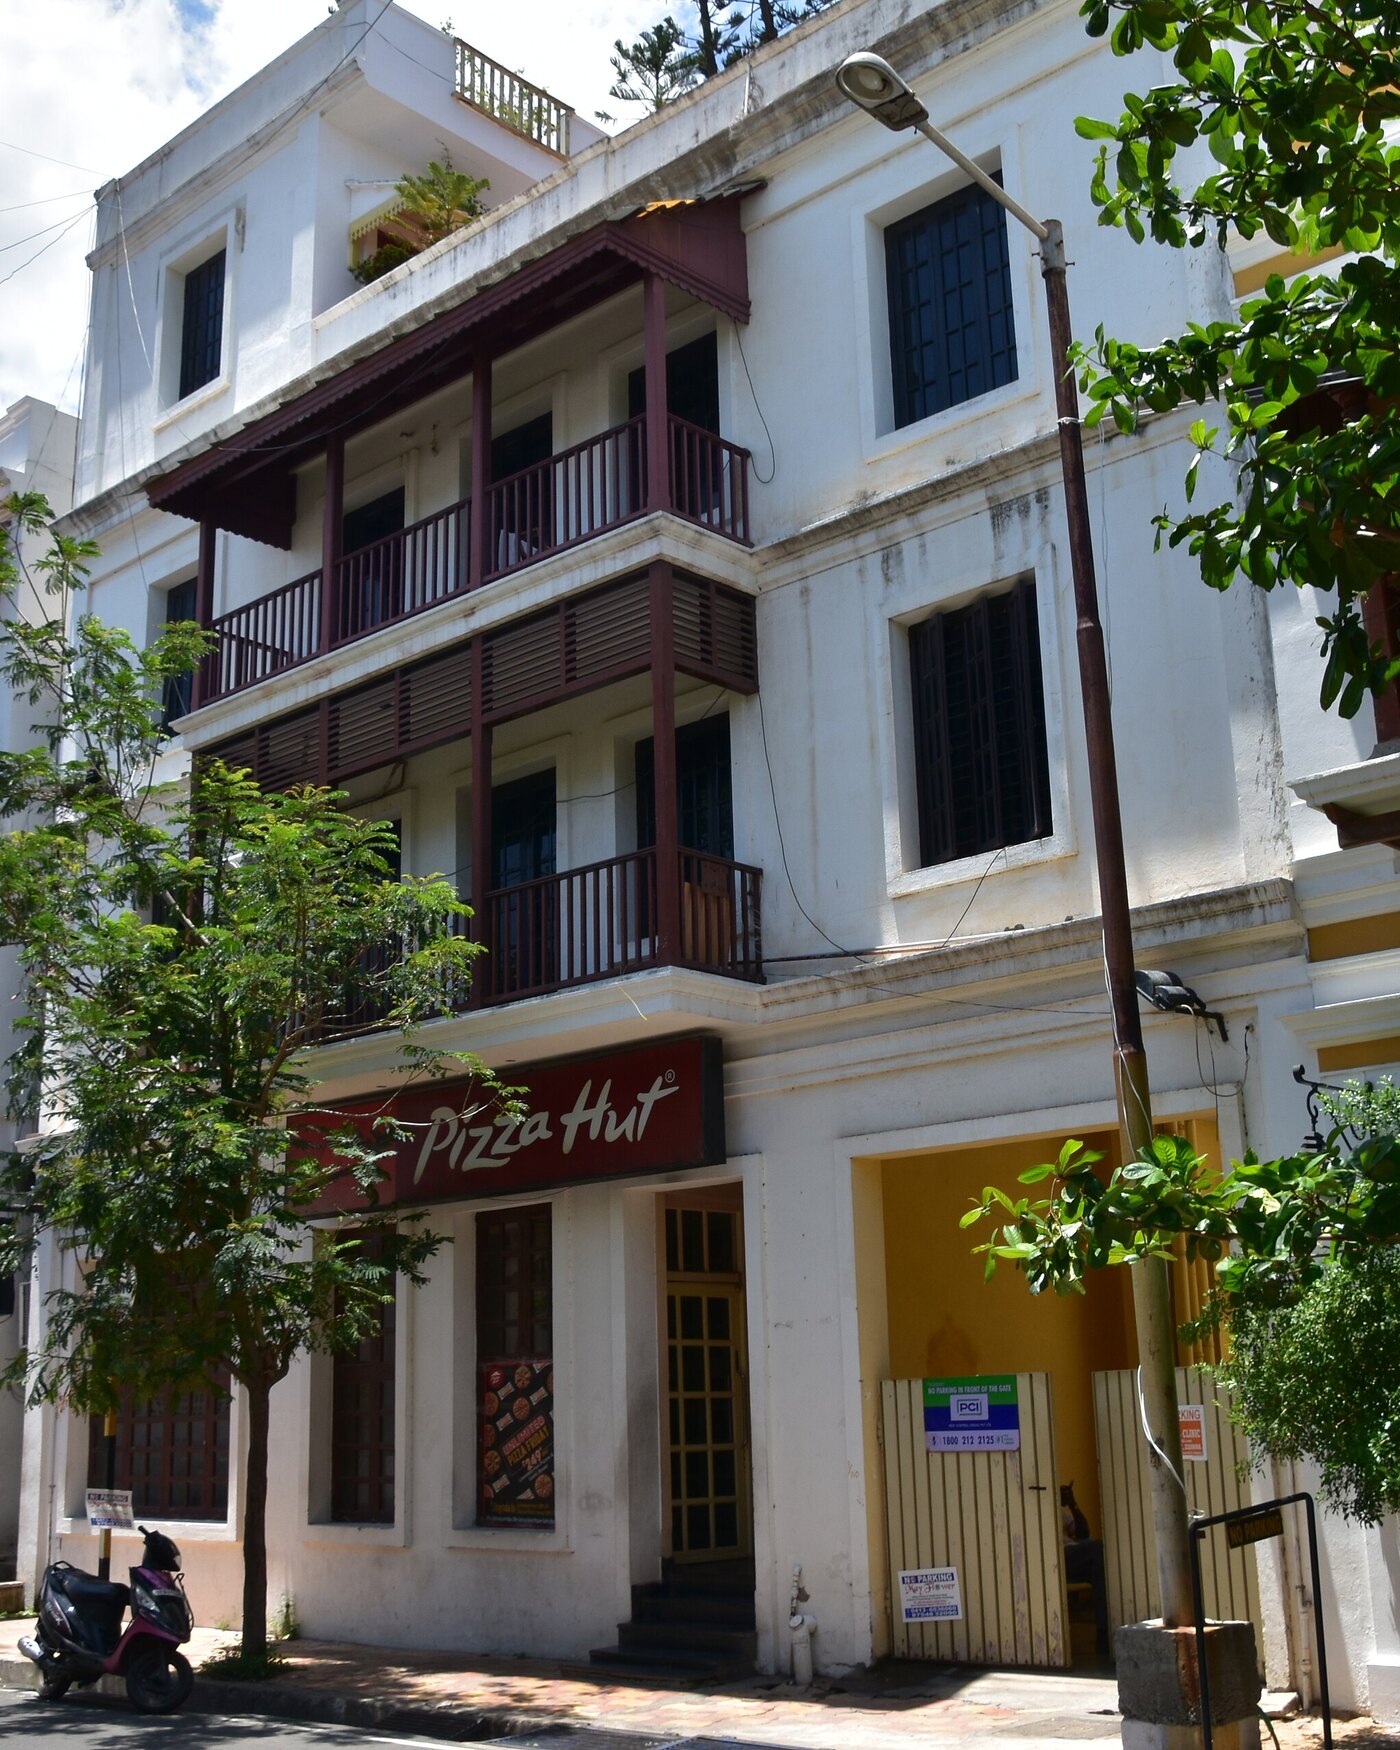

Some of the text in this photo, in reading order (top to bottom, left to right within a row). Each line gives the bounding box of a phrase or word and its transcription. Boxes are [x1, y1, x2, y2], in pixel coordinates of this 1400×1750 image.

[413, 1102, 553, 1185] Pizza
[560, 1075, 680, 1154] Hut
[936, 1386, 957, 1394] PARKING
[964, 1385, 980, 1393] FRONT
[981, 1385, 988, 1393] OF
[989, 1384, 998, 1392] THE
[998, 1384, 1012, 1392] GATE
[960, 1402, 979, 1412] PCI
[943, 1436, 958, 1445] 1800
[962, 1436, 974, 1445] 212
[978, 1435, 995, 1445] 2125
[1245, 1515, 1282, 1540] PARKING
[917, 1573, 952, 1584] PARKING
